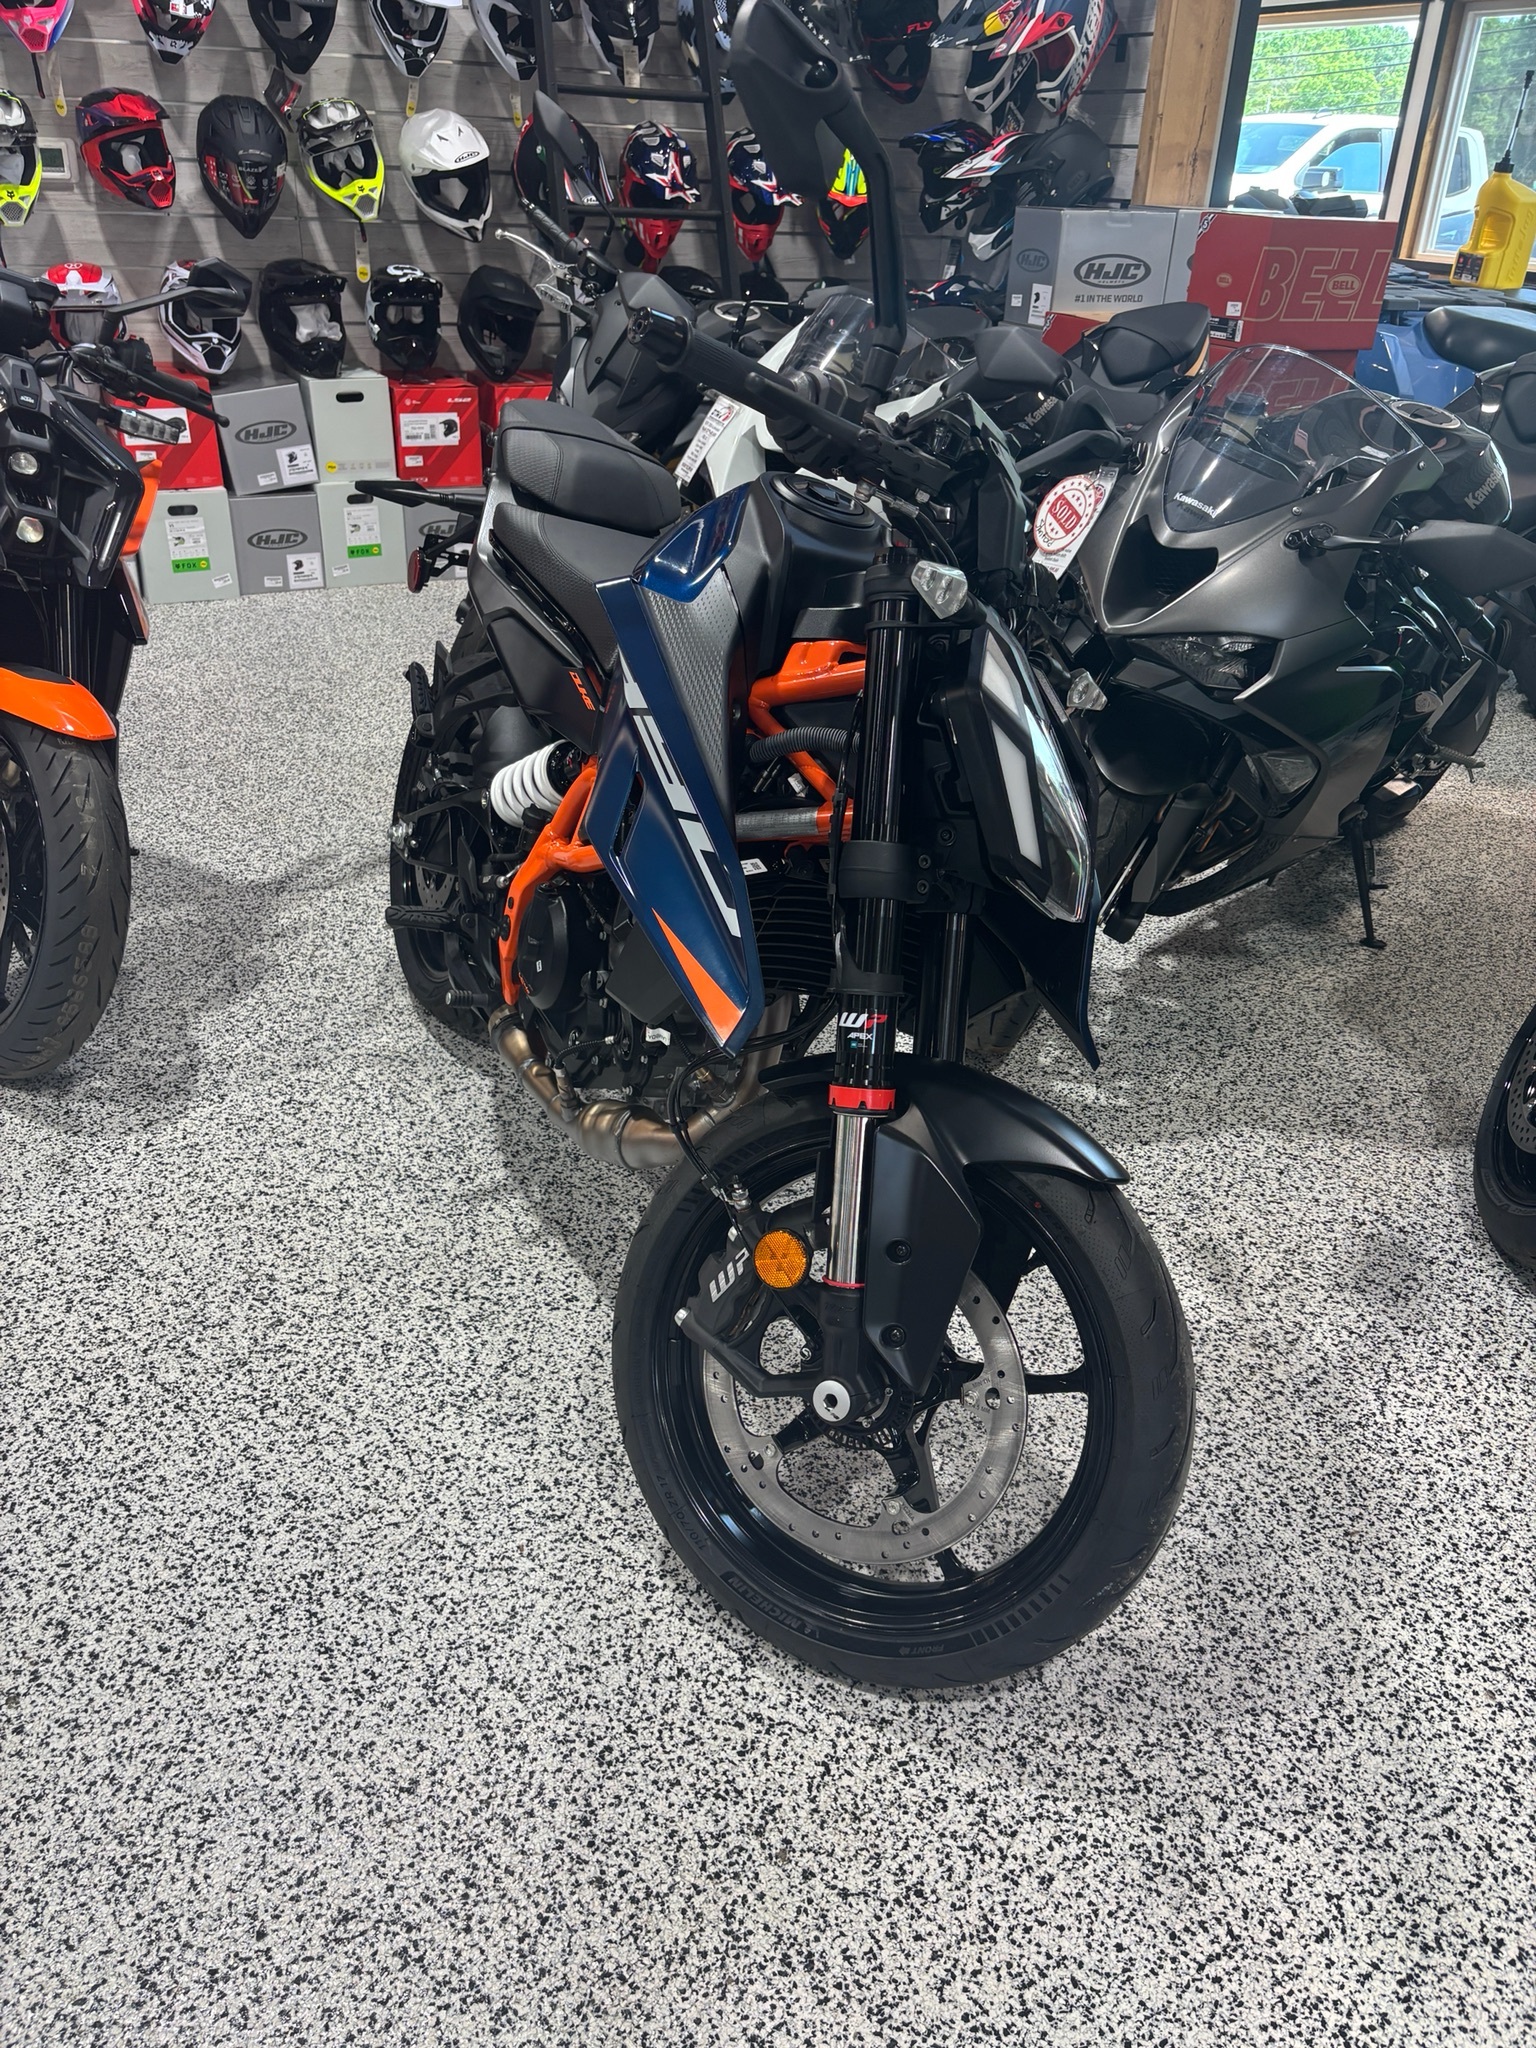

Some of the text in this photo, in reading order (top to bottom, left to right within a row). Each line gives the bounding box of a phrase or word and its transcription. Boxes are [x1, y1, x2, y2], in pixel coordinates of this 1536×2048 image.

[906, 21, 934, 34] FLY
[1021, 254, 1046, 267] HJC
[1083, 263, 1144, 280] HJC
[1331, 280, 1356, 291] BELL
[1074, 294, 1144, 303] #1 IN THE WORLD
[1024, 396, 1059, 426] Kawasa
[244, 424, 288, 441] HJC
[1173, 491, 1218, 518] Kawasaki
[1052, 498, 1078, 530] SOLD
[256, 533, 300, 546] HJC
[569, 671, 596, 711] DUKE
[838, 1011, 888, 1029] WP
[847, 1032, 873, 1040] APEX
[709, 1247, 750, 1303] WP
[656, 1474, 669, 1488] 17
[665, 1491, 679, 1508] ZR
[727, 1574, 803, 1629] MICHELIN
[911, 1643, 945, 1656] FRONT
